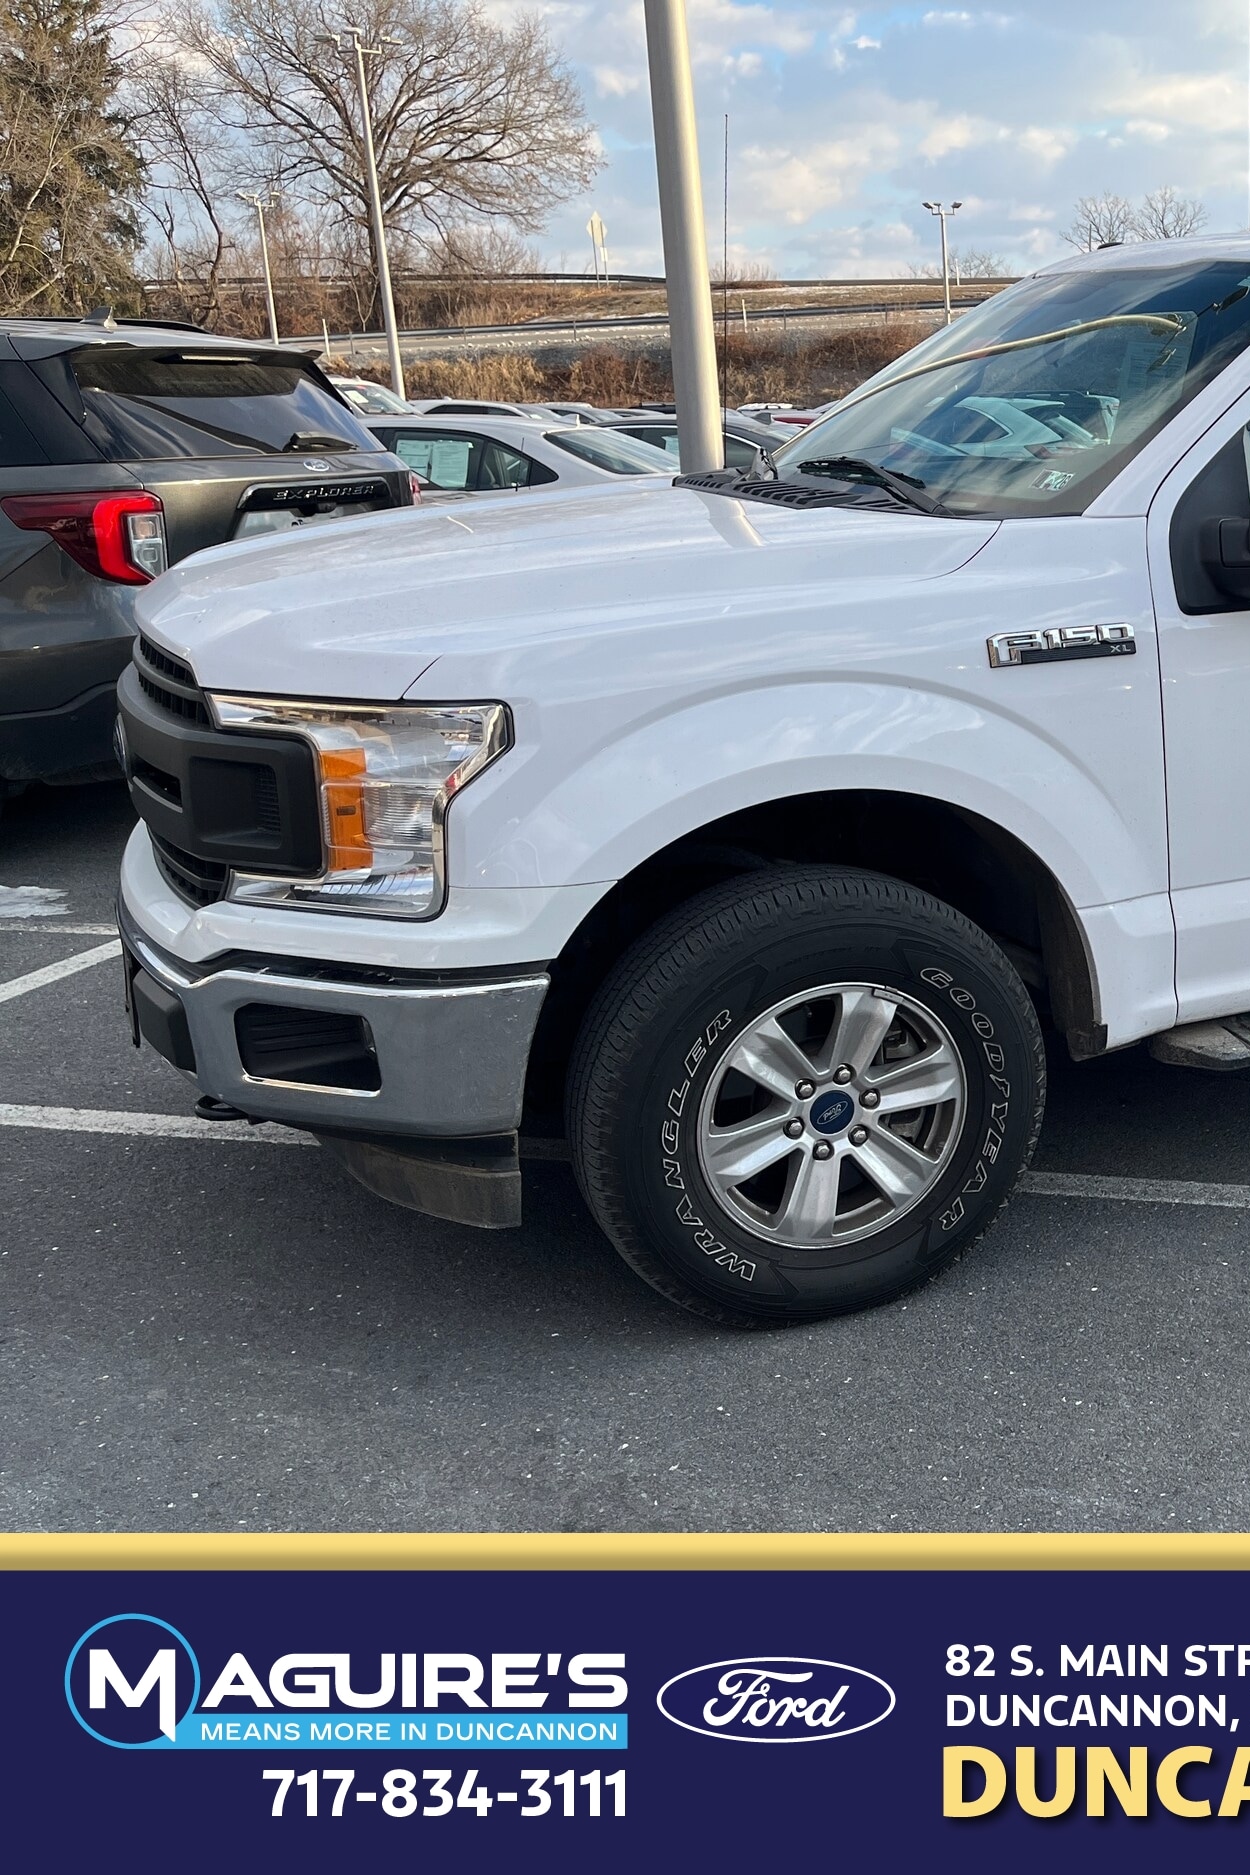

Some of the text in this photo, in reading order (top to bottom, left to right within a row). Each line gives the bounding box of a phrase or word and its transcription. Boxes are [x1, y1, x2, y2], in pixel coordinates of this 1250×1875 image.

[272, 485, 374, 501] EXPLORER
[1109, 644, 1132, 654] XL
[661, 1008, 757, 1282] WRANGLER
[920, 967, 1010, 1231] GOODYEAR
